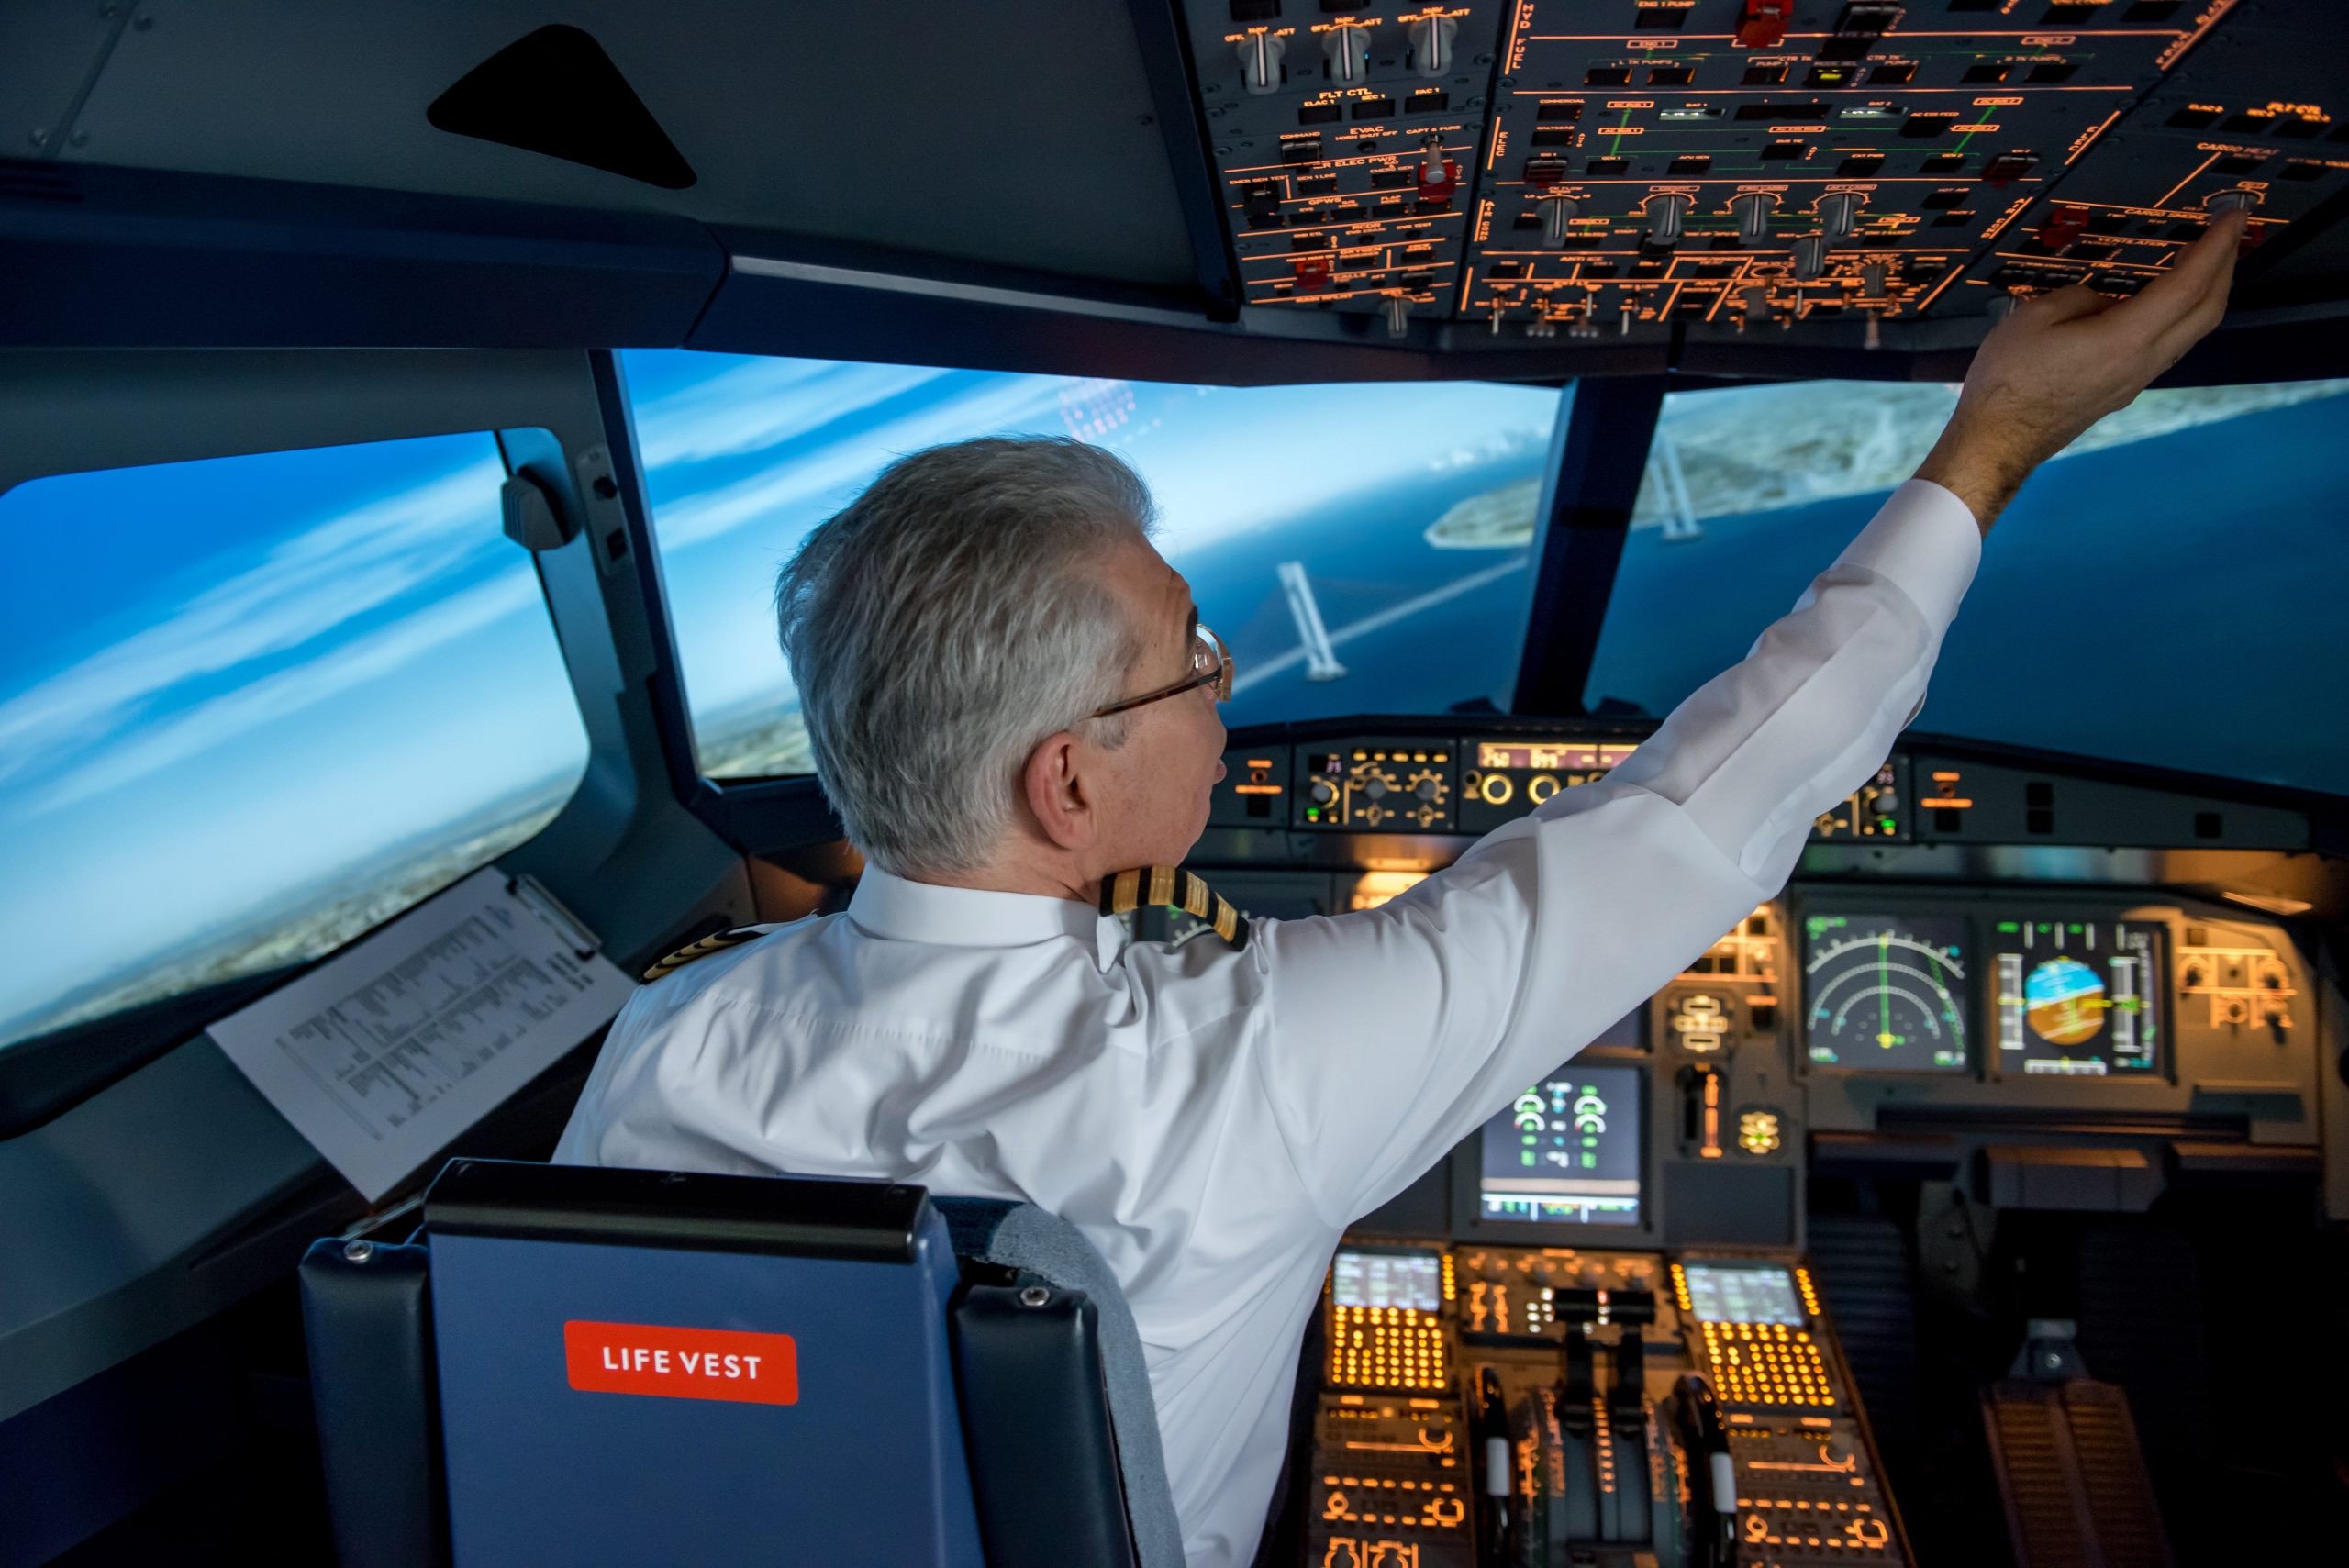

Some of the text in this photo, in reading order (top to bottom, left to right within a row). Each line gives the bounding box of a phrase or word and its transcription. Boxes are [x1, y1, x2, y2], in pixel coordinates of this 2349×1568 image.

[1520, 4, 1534, 28] HYD
[1275, 28, 1296, 36] ATT
[1511, 38, 1527, 69] FUEL
[1319, 87, 1373, 99] FLT CTL
[1279, 131, 1321, 139] COMMAND
[1349, 126, 1385, 135] EVAC
[1496, 131, 1508, 157] ELEC
[2197, 141, 2243, 152] CARGO
[1334, 158, 1365, 167] ELEC
[1368, 155, 1397, 164] PWR
[602, 1346, 762, 1379] LIFE VEST
